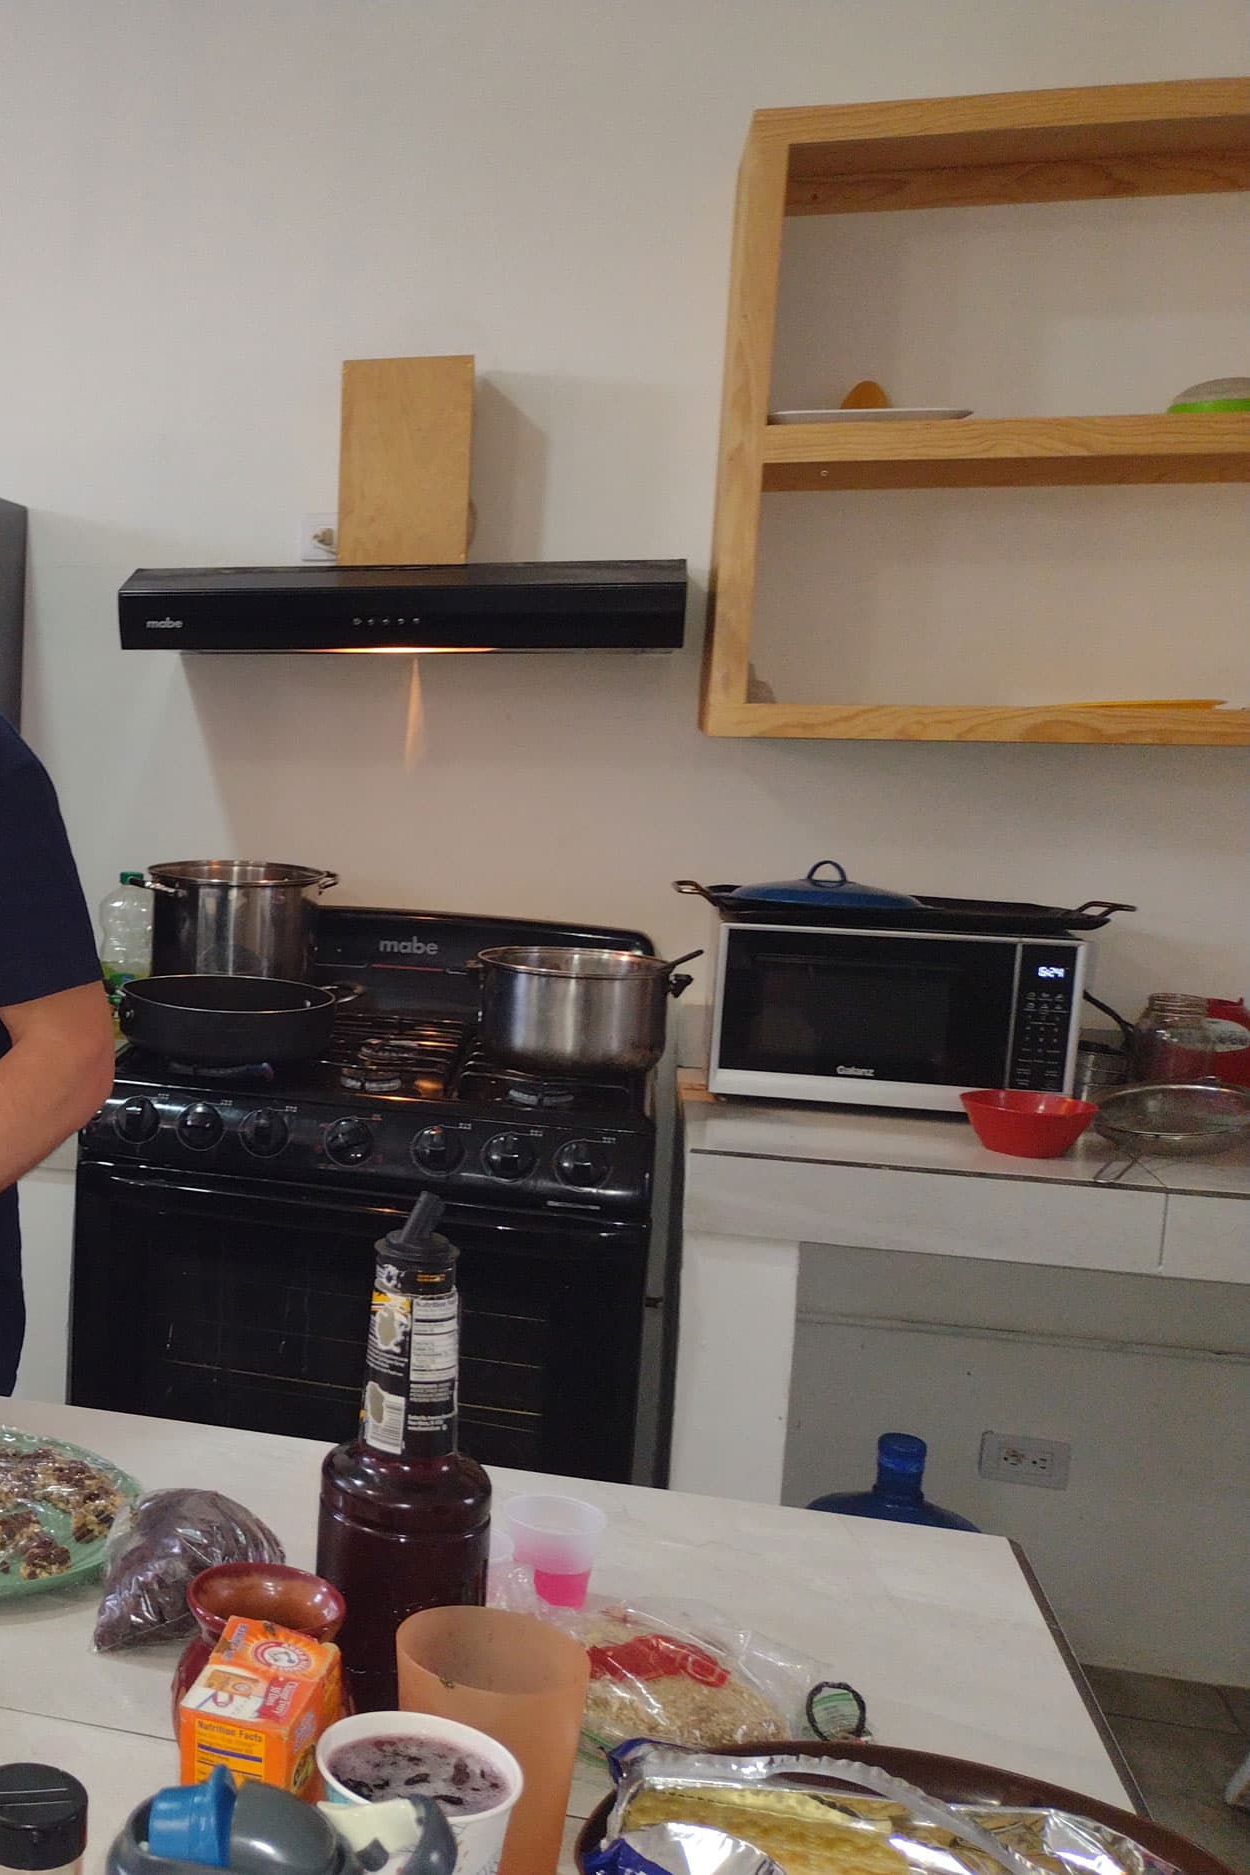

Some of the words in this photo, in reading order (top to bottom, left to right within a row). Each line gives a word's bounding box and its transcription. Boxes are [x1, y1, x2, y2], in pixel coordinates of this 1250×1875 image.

[146, 616, 183, 629] mabe
[379, 935, 438, 955] mabe
[197, 1720, 236, 1736] Nutrition
[239, 1730, 263, 1742] Facts
